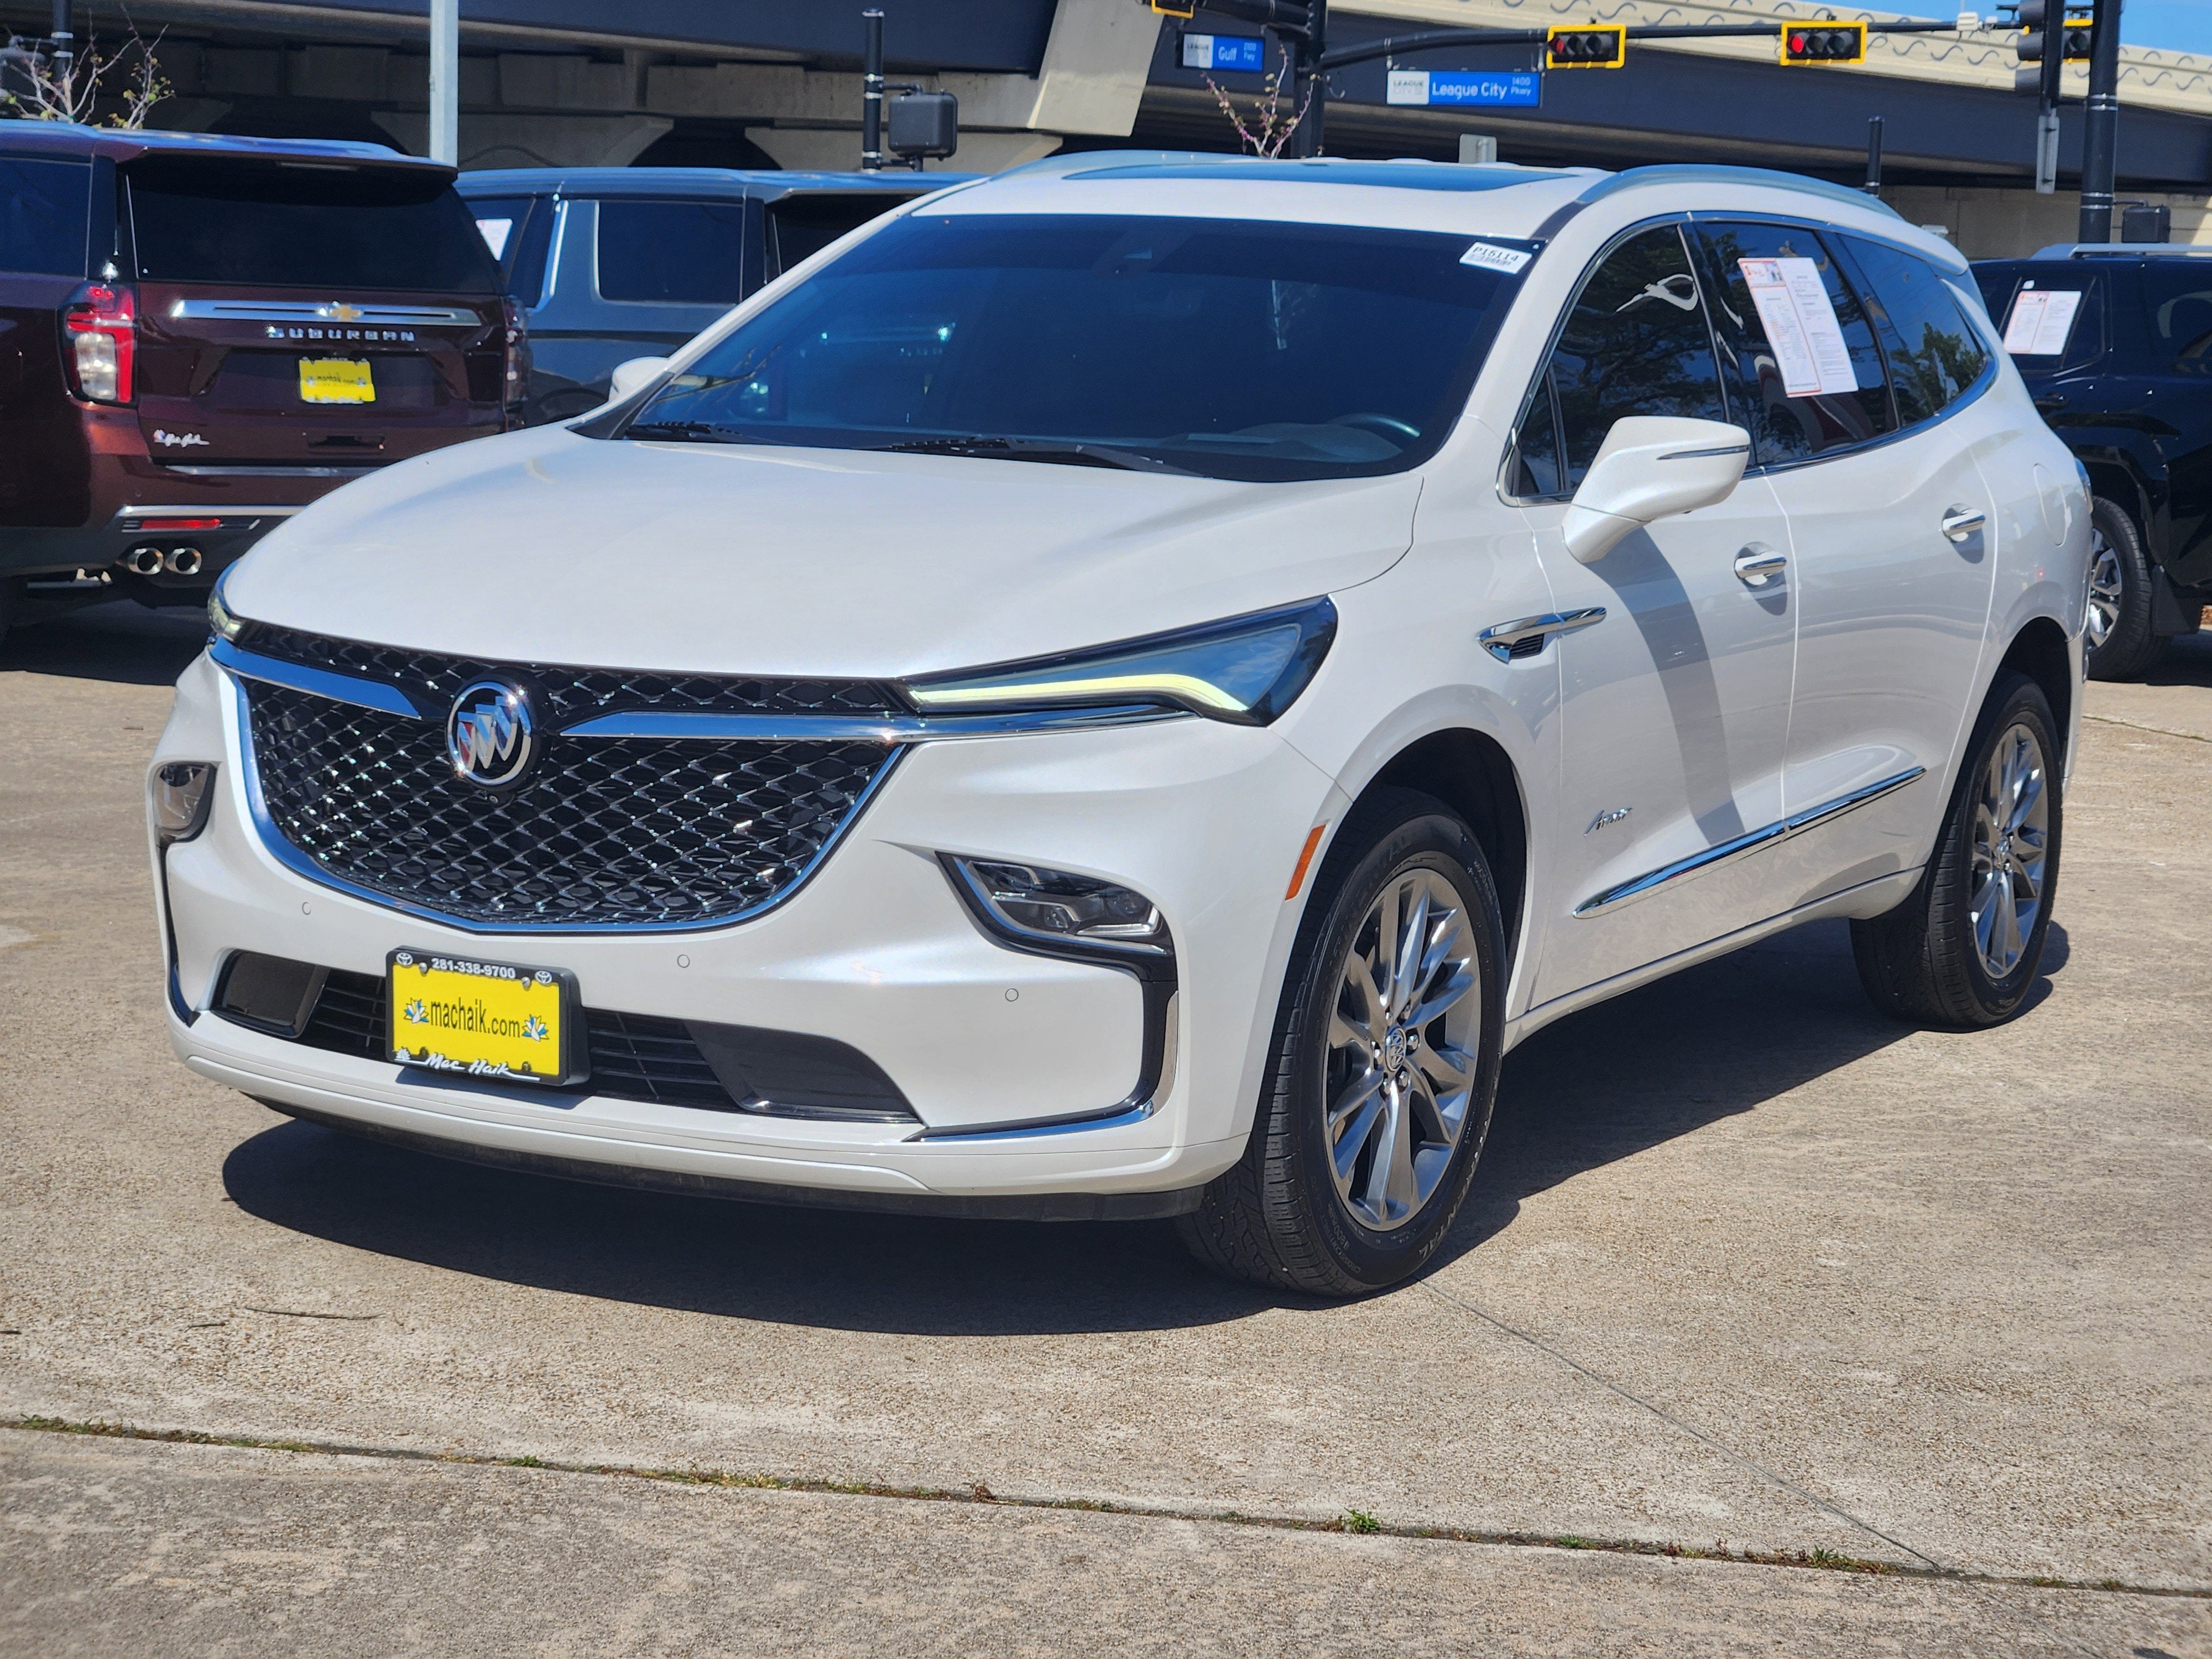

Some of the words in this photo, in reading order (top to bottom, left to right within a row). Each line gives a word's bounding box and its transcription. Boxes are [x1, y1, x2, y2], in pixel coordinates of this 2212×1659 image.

[1218, 46, 1238, 61] Gulf
[1432, 81, 1479, 100] League
[1481, 82, 1507, 100] City
[1512, 76, 1531, 86] 1400
[267, 327, 415, 342] SUBURBAN
[431, 957, 517, 979] 281-338-9700
[430, 997, 521, 1038] machaik.com
[425, 1053, 466, 1071] Mac
[468, 1058, 519, 1077] Haik
